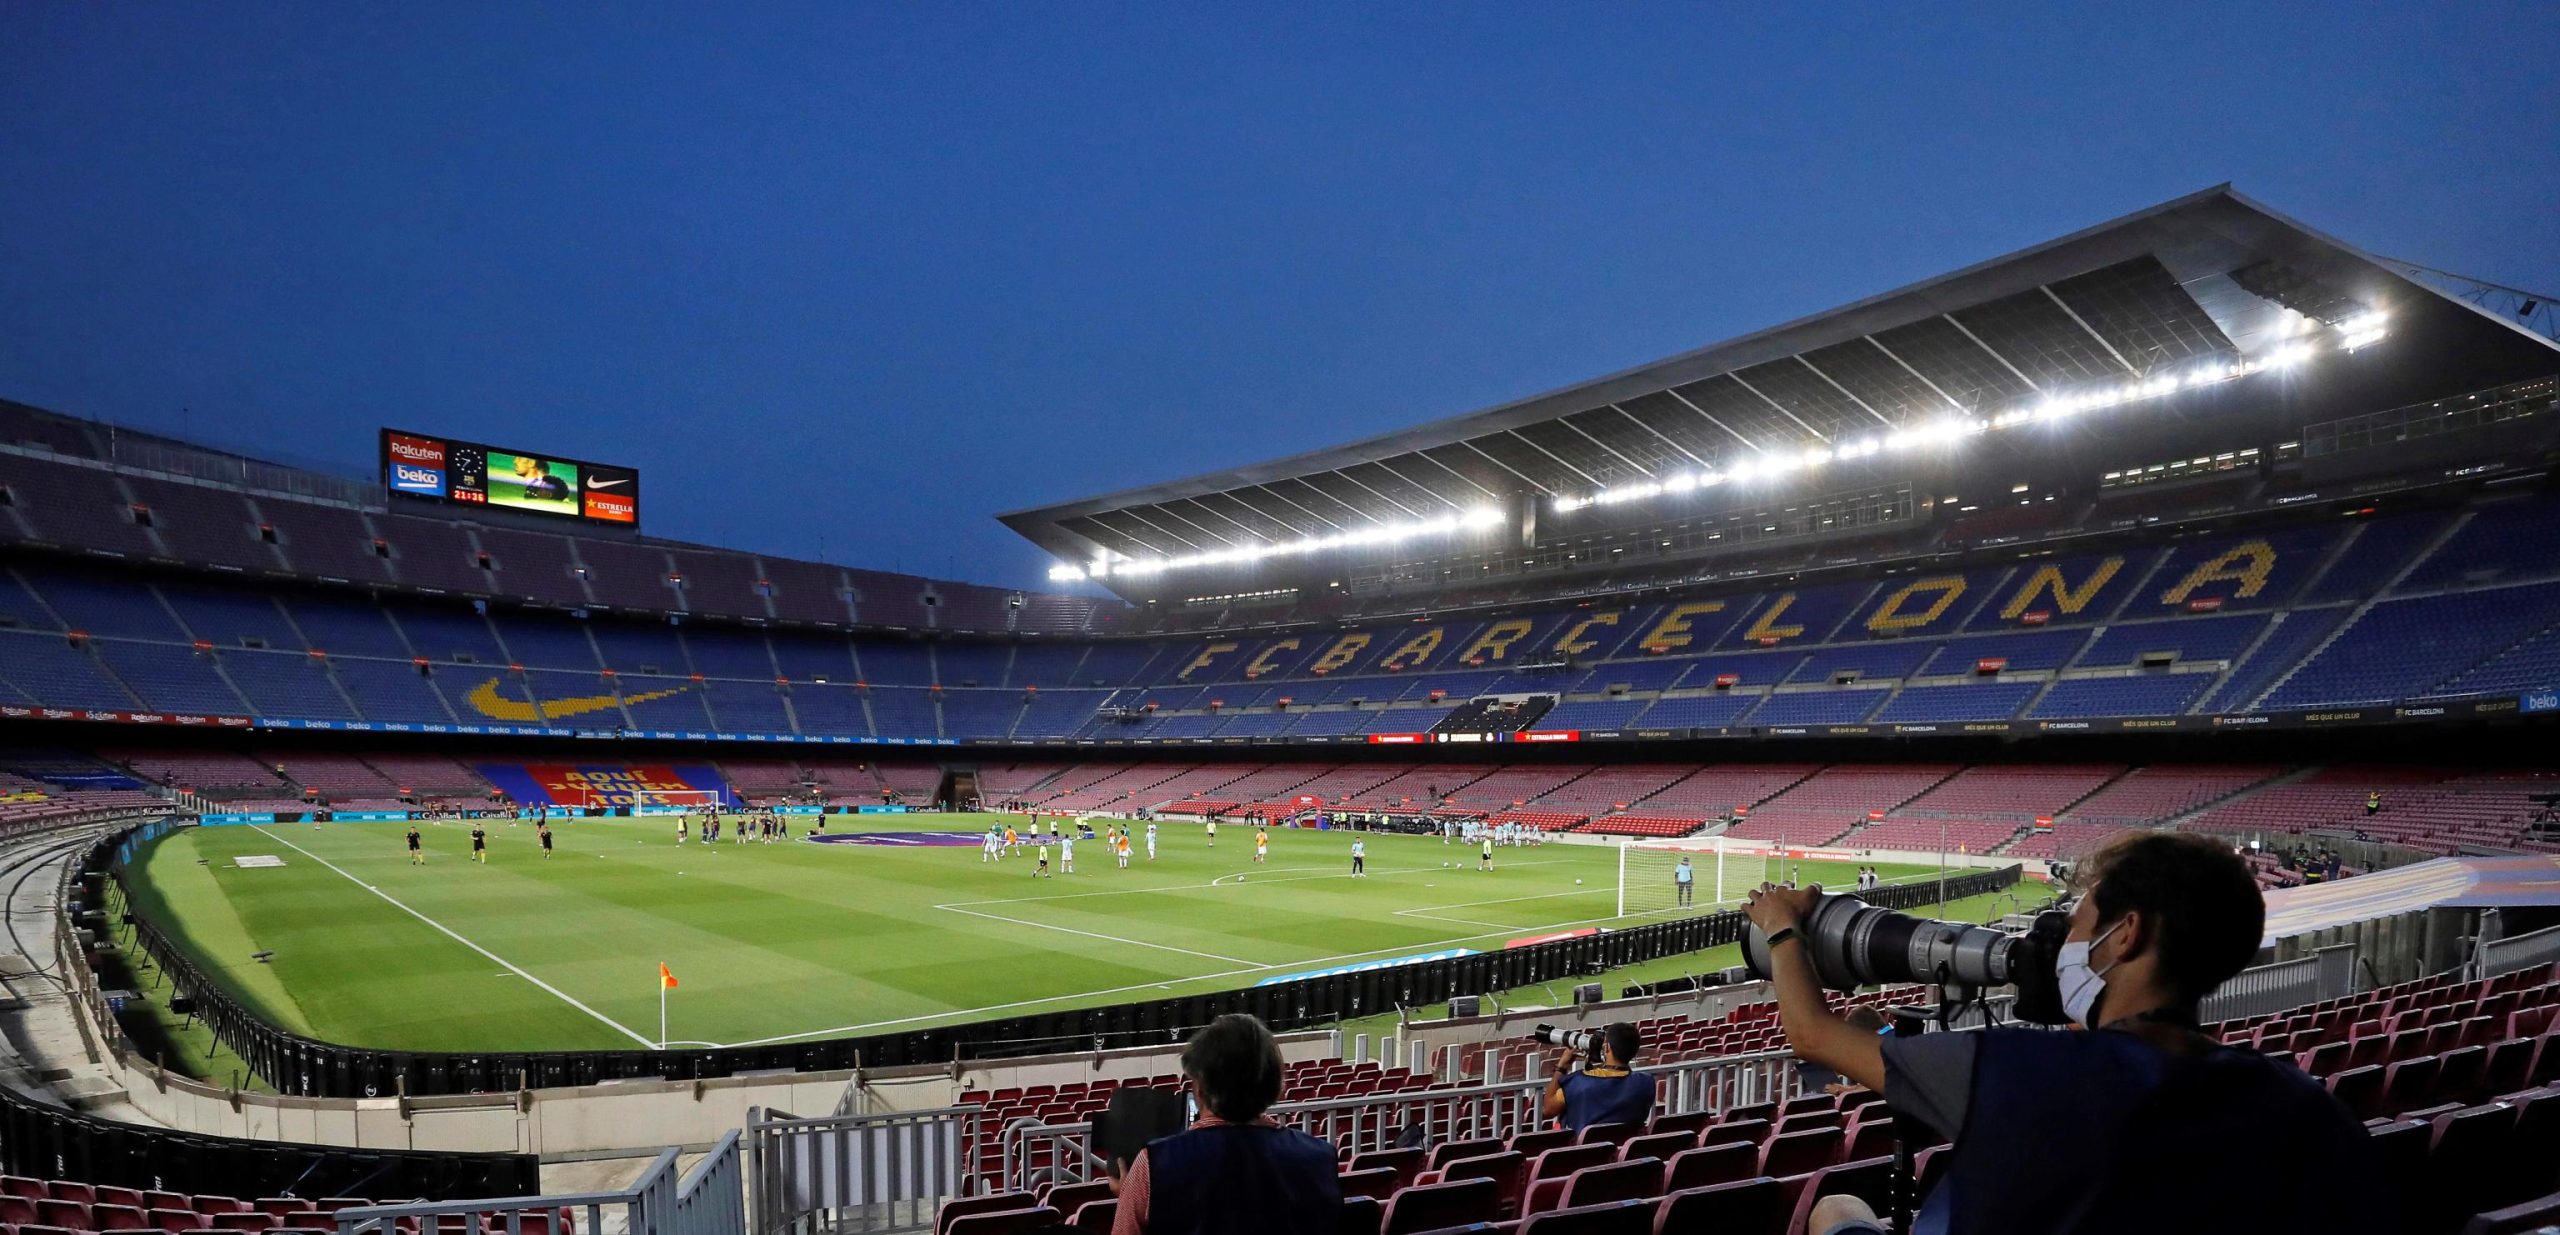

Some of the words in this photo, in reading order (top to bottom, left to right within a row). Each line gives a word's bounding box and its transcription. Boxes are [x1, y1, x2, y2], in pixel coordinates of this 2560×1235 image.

[392, 443, 442, 460] Rakuten
[397, 466, 438, 483] beko
[598, 502, 633, 512] ESTRELLA
[2529, 695, 2558, 709] beko
[43, 709, 73, 718] Rakuten
[131, 713, 164, 722] Rakuten
[176, 715, 206, 724] Rakuten
[218, 717, 248, 726] Rakuten
[263, 719, 290, 727] beko
[305, 720, 330, 728] beko
[346, 722, 370, 730] beko
[385, 723, 409, 731] beko
[423, 724, 446, 732] beko
[457, 725, 480, 733] beko
